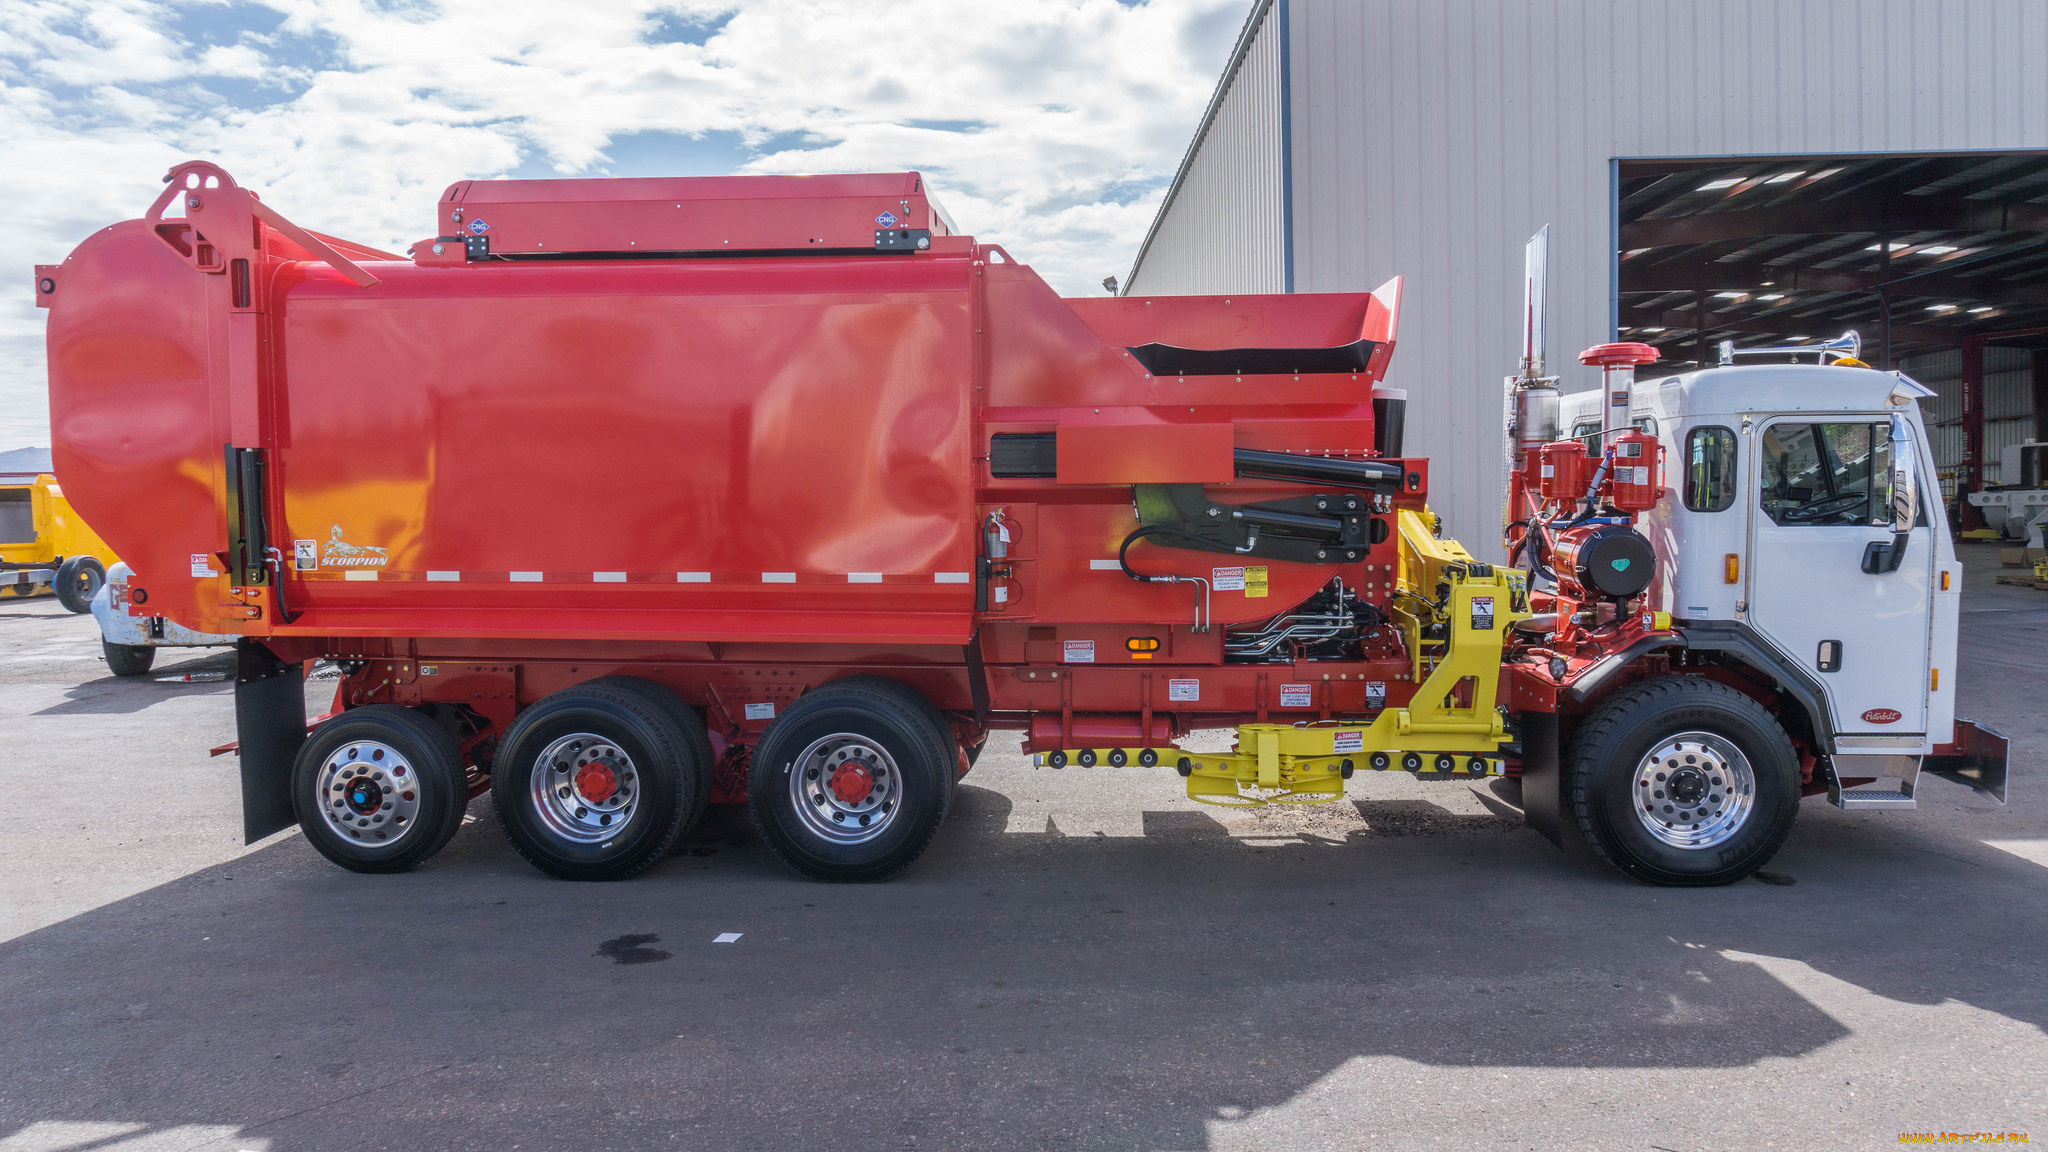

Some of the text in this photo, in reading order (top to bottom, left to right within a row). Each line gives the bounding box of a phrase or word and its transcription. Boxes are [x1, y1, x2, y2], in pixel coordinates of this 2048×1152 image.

[320, 557, 388, 566] SCORPION
[1220, 569, 1243, 577] DANGER
[1865, 710, 1900, 721] Peterbilt
